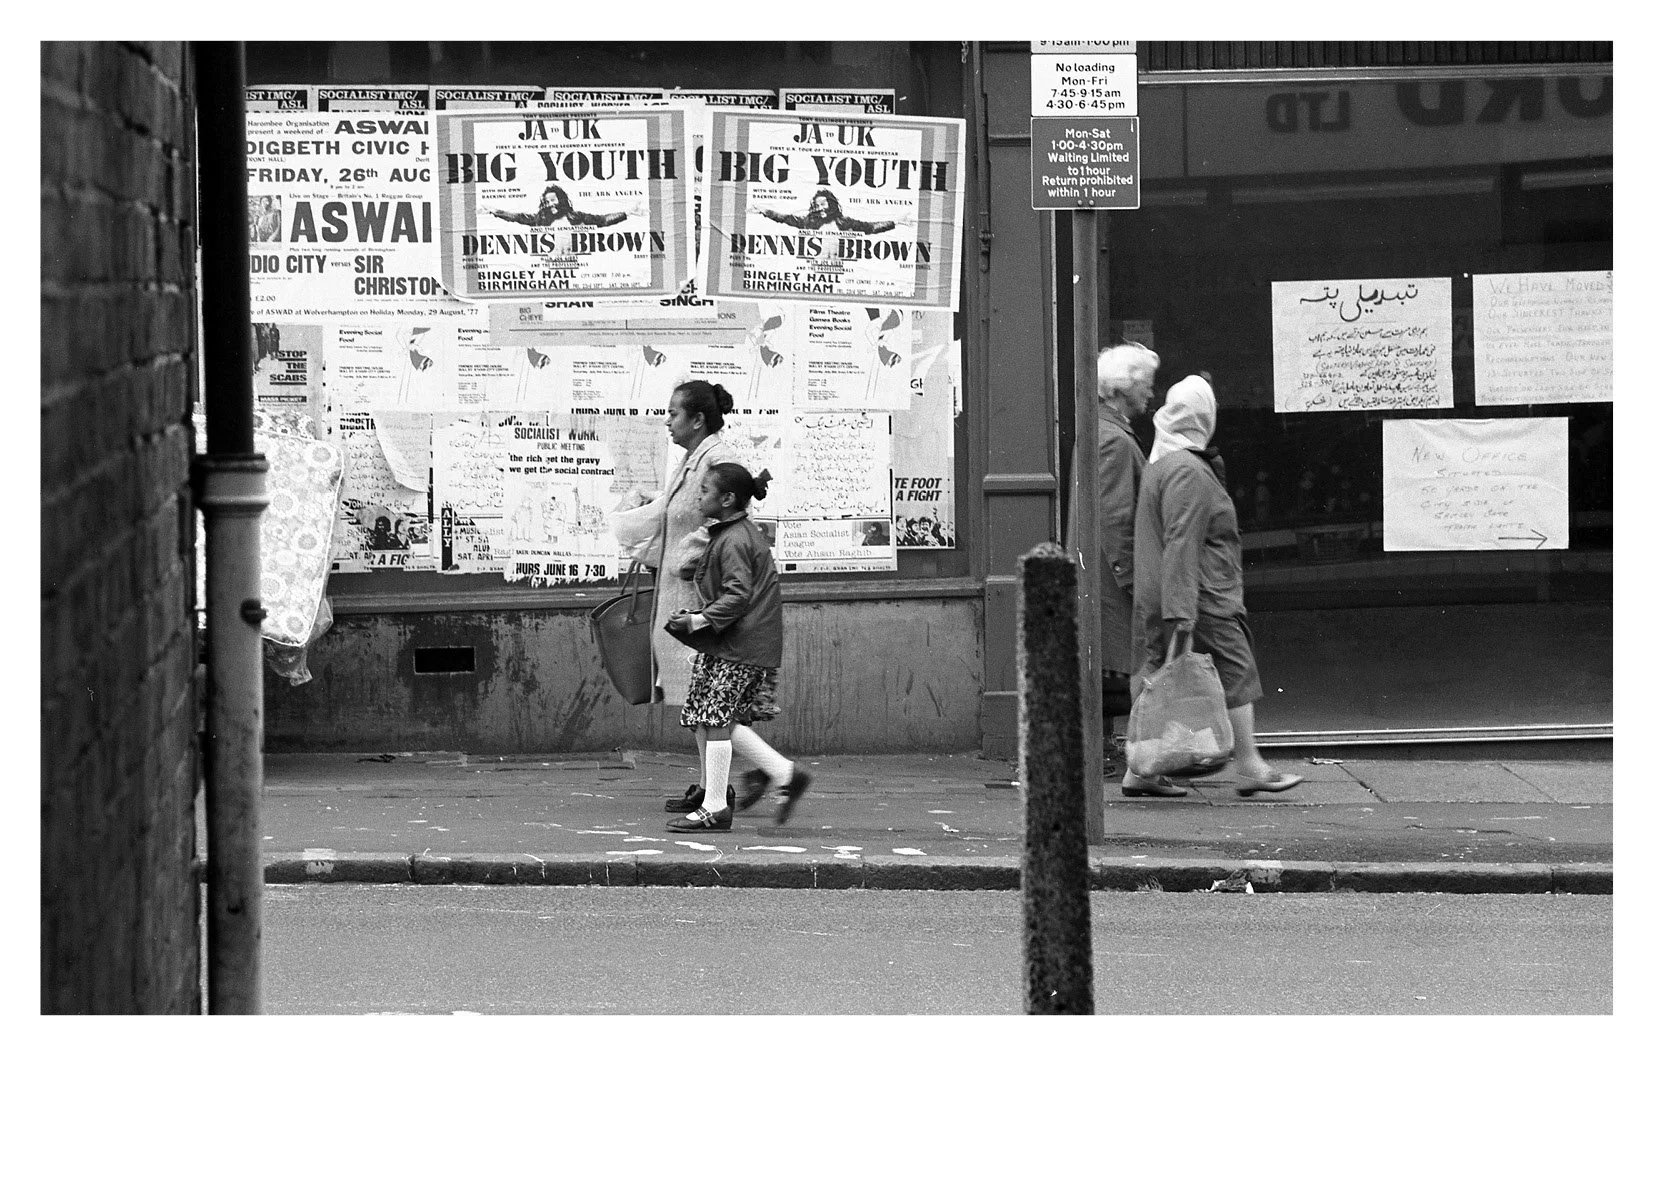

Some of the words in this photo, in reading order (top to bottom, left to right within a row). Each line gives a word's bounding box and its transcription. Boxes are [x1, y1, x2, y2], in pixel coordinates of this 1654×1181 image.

[1056, 63, 1072, 72] No
[1074, 63, 1115, 74] loading
[1062, 76, 1108, 86] Mon-Fri
[320, 90, 386, 100] SOCIALIST
[388, 91, 419, 100] IMG/
[437, 90, 503, 101] SOCIALIST
[505, 92, 535, 100] IMG/
[555, 92, 622, 101] SOCIALIST
[787, 94, 851, 104] SOCIALIST
[854, 95, 884, 104] IMG/
[1104, 90, 1121, 98] am
[280, 101, 305, 109] ASL
[402, 100, 426, 109] ASL
[867, 105, 891, 114] ASL
[1108, 102, 1125, 111] pm
[518, 120, 549, 140] JA
[563, 120, 602, 140] UK
[794, 123, 824, 145] JA
[838, 125, 876, 147] UK
[1066, 129, 1111, 139] Mon-Sat
[246, 141, 340, 155] DIGBETH
[352, 141, 410, 155] CIVIC
[1048, 153, 1089, 165] Waiting
[1090, 152, 1130, 163] Limited
[446, 152, 518, 184] BIG
[538, 149, 678, 182] YOUTH
[1068, 167, 1079, 176] to
[1080, 166, 1085, 176] 1
[1086, 166, 1111, 176] hour
[246, 168, 329, 184] FRIDAY,
[339, 168, 378, 182] 26th
[389, 168, 431, 182] AUG
[718, 152, 790, 183] BIG
[811, 155, 950, 192] YOUTH
[1042, 176, 1078, 186] Return
[1080, 176, 1134, 188] prohibited
[1048, 188, 1080, 197] within
[1084, 188, 1089, 197] 1
[1091, 188, 1117, 197] hour
[462, 233, 556, 256] DENNIS
[571, 232, 666, 253] BROWN
[731, 233, 823, 257] DENNIS
[838, 238, 931, 263] BROWN
[251, 255, 280, 274] DIO
[286, 255, 327, 274] CITY
[354, 255, 384, 274] SIR
[478, 271, 535, 280] BINGLEY
[543, 270, 577, 279] HALL
[743, 271, 800, 281] BINGLEY
[807, 274, 841, 284] HALL
[478, 280, 569, 291] BIRMINGHAM
[743, 280, 834, 294] BIRMINGHAM
[304, 309, 358, 317] Wolverhampton
[370, 309, 395, 317] Holiday
[270, 374, 307, 382] SCABS
[515, 428, 560, 440] SOCIALIST
[537, 442, 558, 451] PUBLIC
[561, 443, 586, 451] MEETING
[1412, 446, 1445, 463] NEW
[1462, 448, 1526, 463] OFFICE
[577, 457, 600, 465] gravy
[524, 466, 537, 475] get
[555, 467, 579, 475] social
[911, 478, 942, 489] FOOT
[896, 490, 904, 501] A
[907, 490, 942, 501] FIGHT
[810, 529, 849, 538] Socialist
[784, 541, 815, 549] League
[807, 550, 835, 558] Ahsan
[544, 564, 566, 576] JUNE
[569, 564, 579, 577] 16
